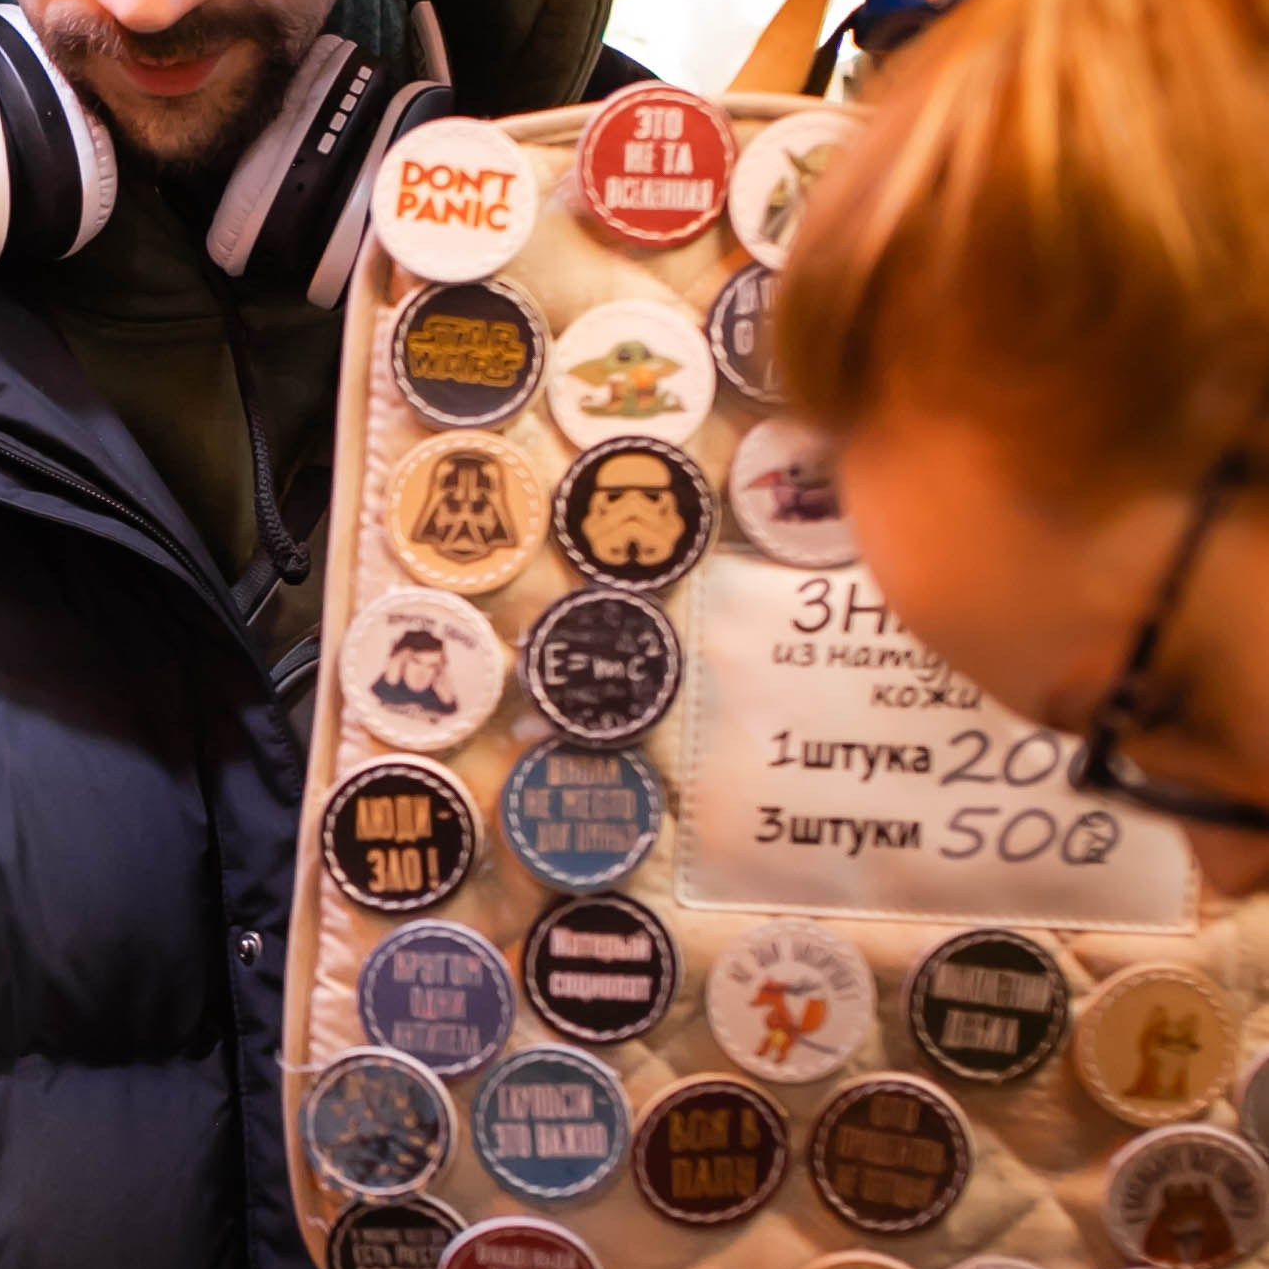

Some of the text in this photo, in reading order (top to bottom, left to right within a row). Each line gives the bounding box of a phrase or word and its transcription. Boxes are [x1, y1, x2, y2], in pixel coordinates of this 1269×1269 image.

[634, 105, 685, 141] ЭТО
[624, 141, 694, 175] НЕ ТА
[396, 190, 513, 232] PANIC
[771, 641, 813, 668] из
[870, 681, 984, 711] кожи
